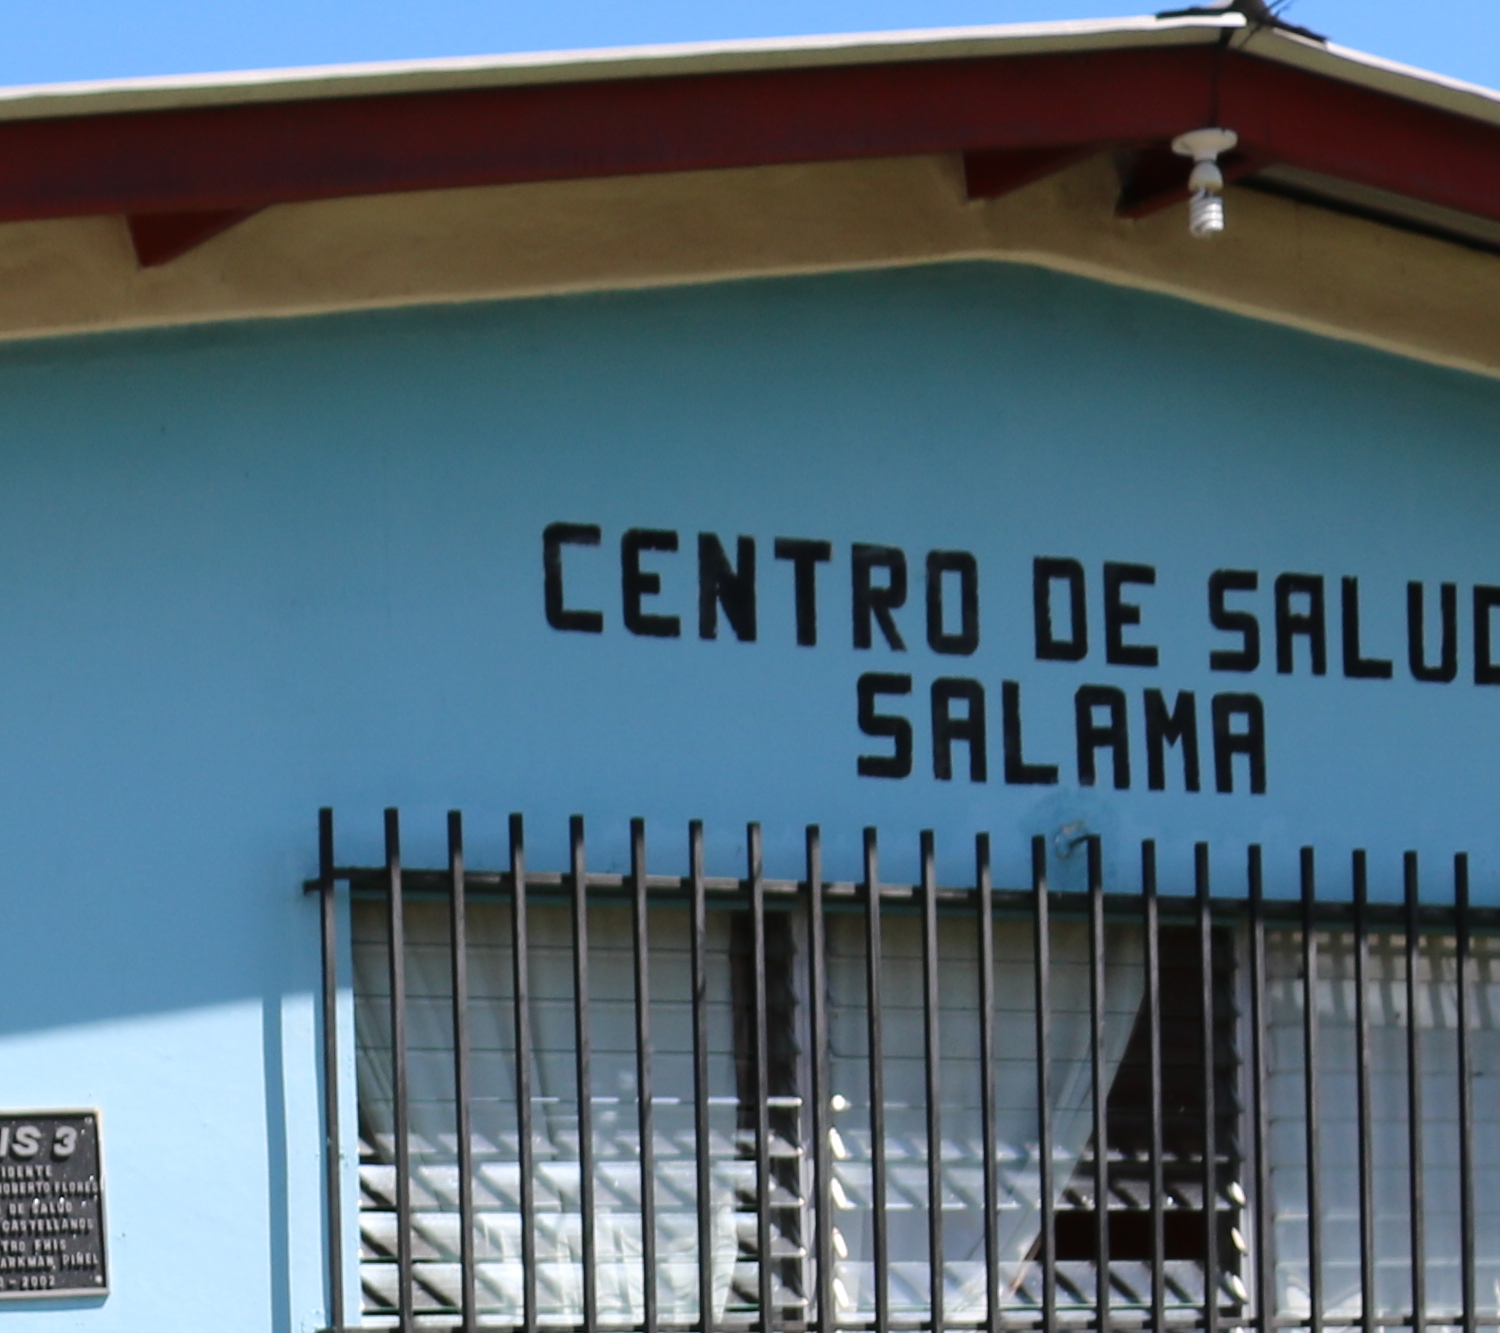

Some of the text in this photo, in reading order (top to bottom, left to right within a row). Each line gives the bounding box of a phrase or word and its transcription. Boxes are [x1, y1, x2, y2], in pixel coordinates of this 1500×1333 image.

[543, 521, 978, 656] CENTRO
[1033, 556, 1159, 667] DE
[856, 673, 1266, 796] SALAMA
[53, 1126, 78, 1157] 3
[55, 1181, 99, 1194] FLORES
[9, 1203, 24, 1215] DE
[32, 1201, 73, 1215] SALUD
[2, 1218, 94, 1232] CASTELLANOS
[34, 1238, 67, 1252] FHIS
[22, 1276, 56, 1288] 2002
